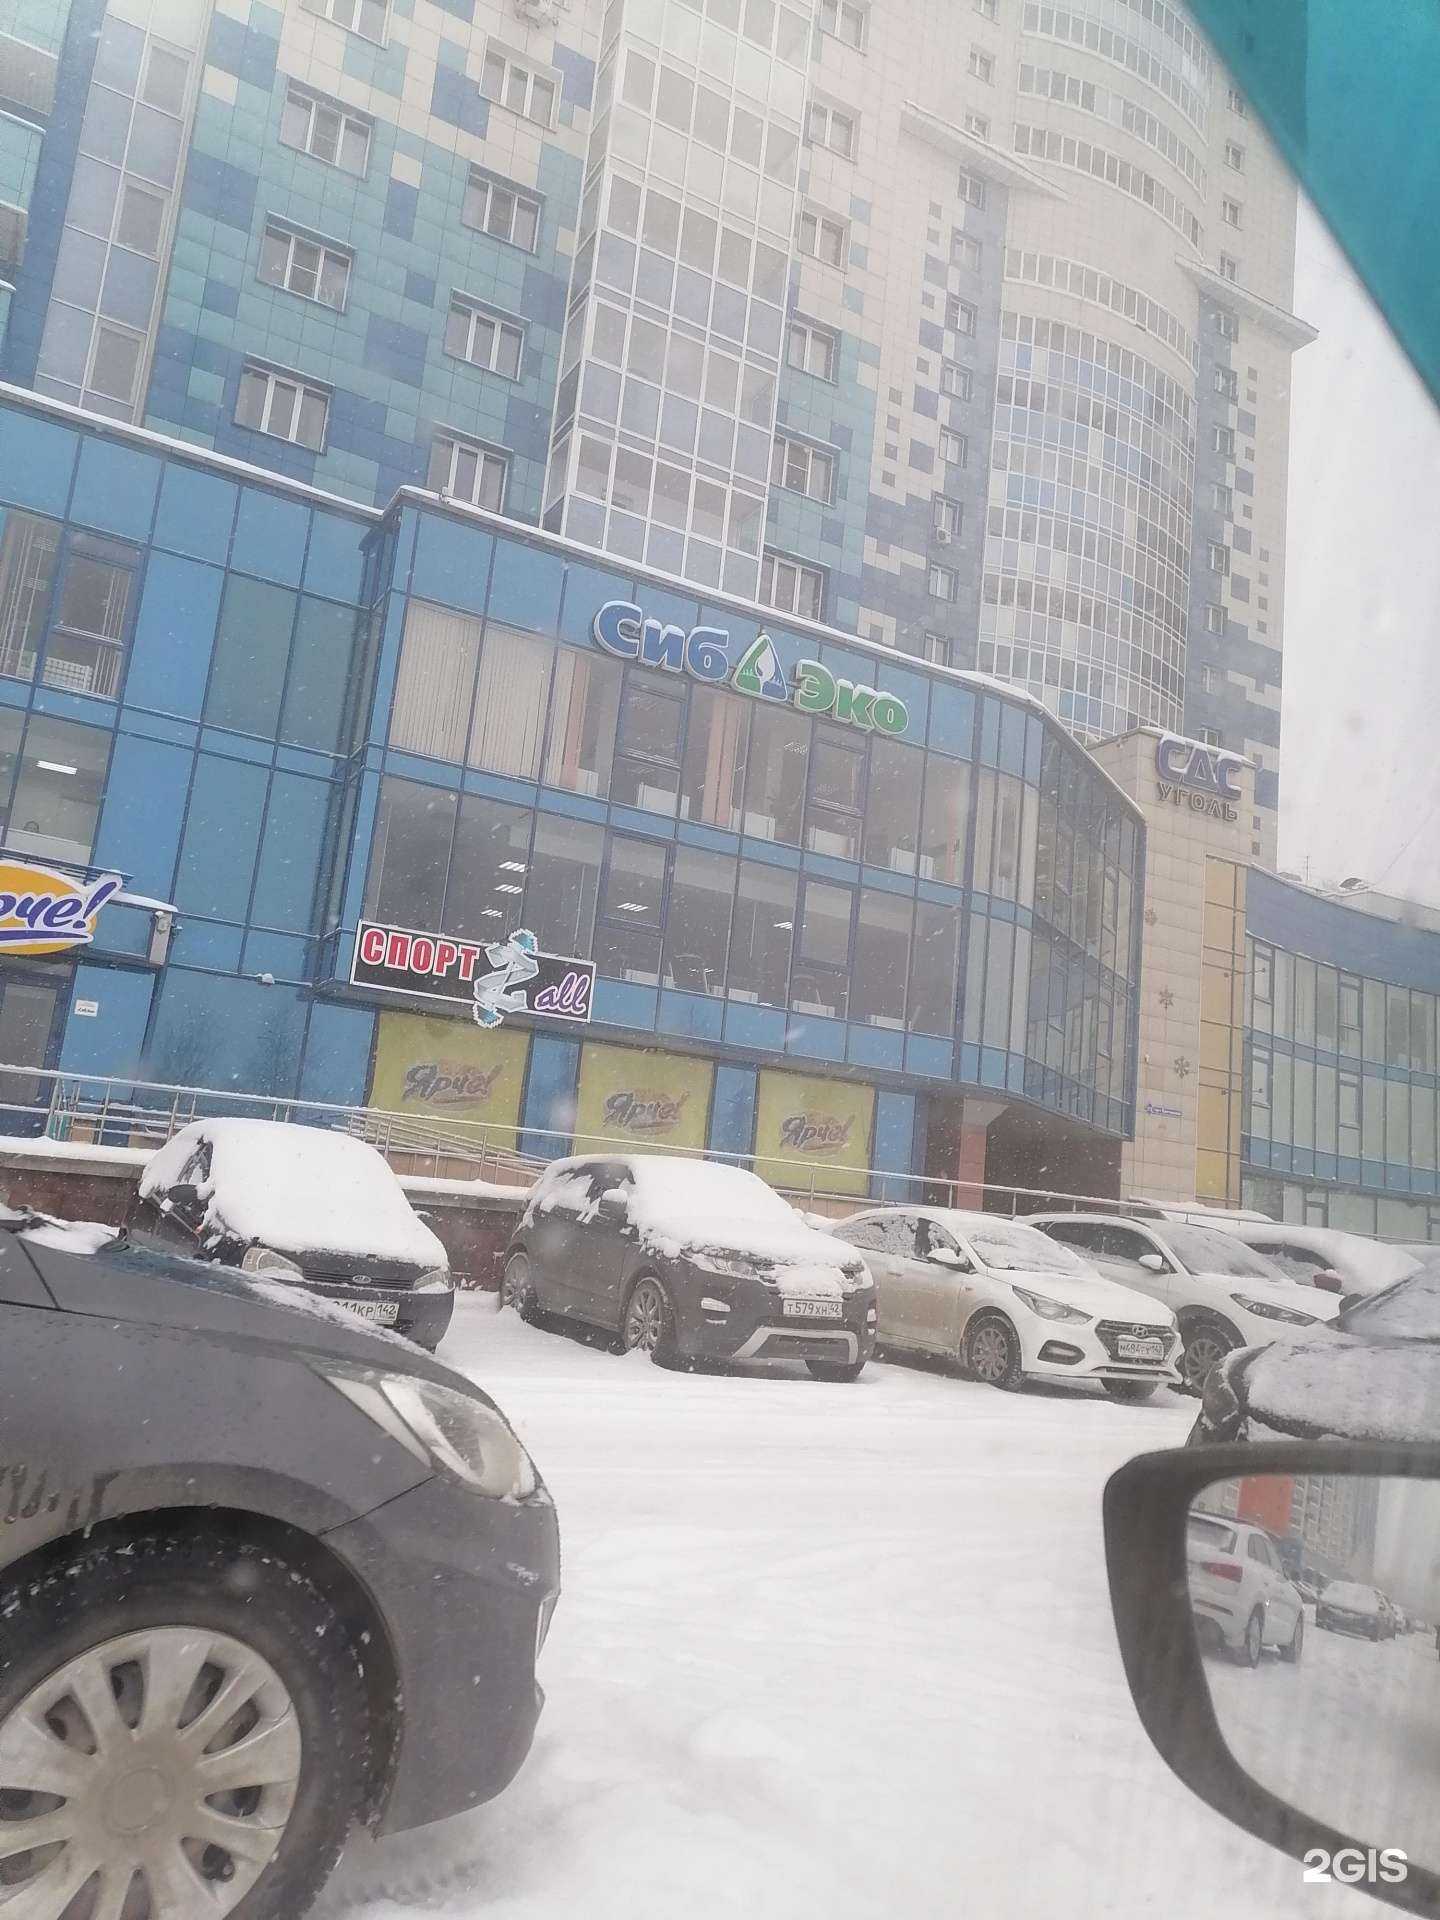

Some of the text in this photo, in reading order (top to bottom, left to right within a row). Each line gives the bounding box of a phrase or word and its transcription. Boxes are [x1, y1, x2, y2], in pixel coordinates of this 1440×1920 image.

[593, 600, 909, 735] Сиб Эко
[1157, 780, 1238, 821] УГОЛЬ
[361, 928, 480, 981] СПОРТ
[402, 1064, 503, 1102] Ярче!
